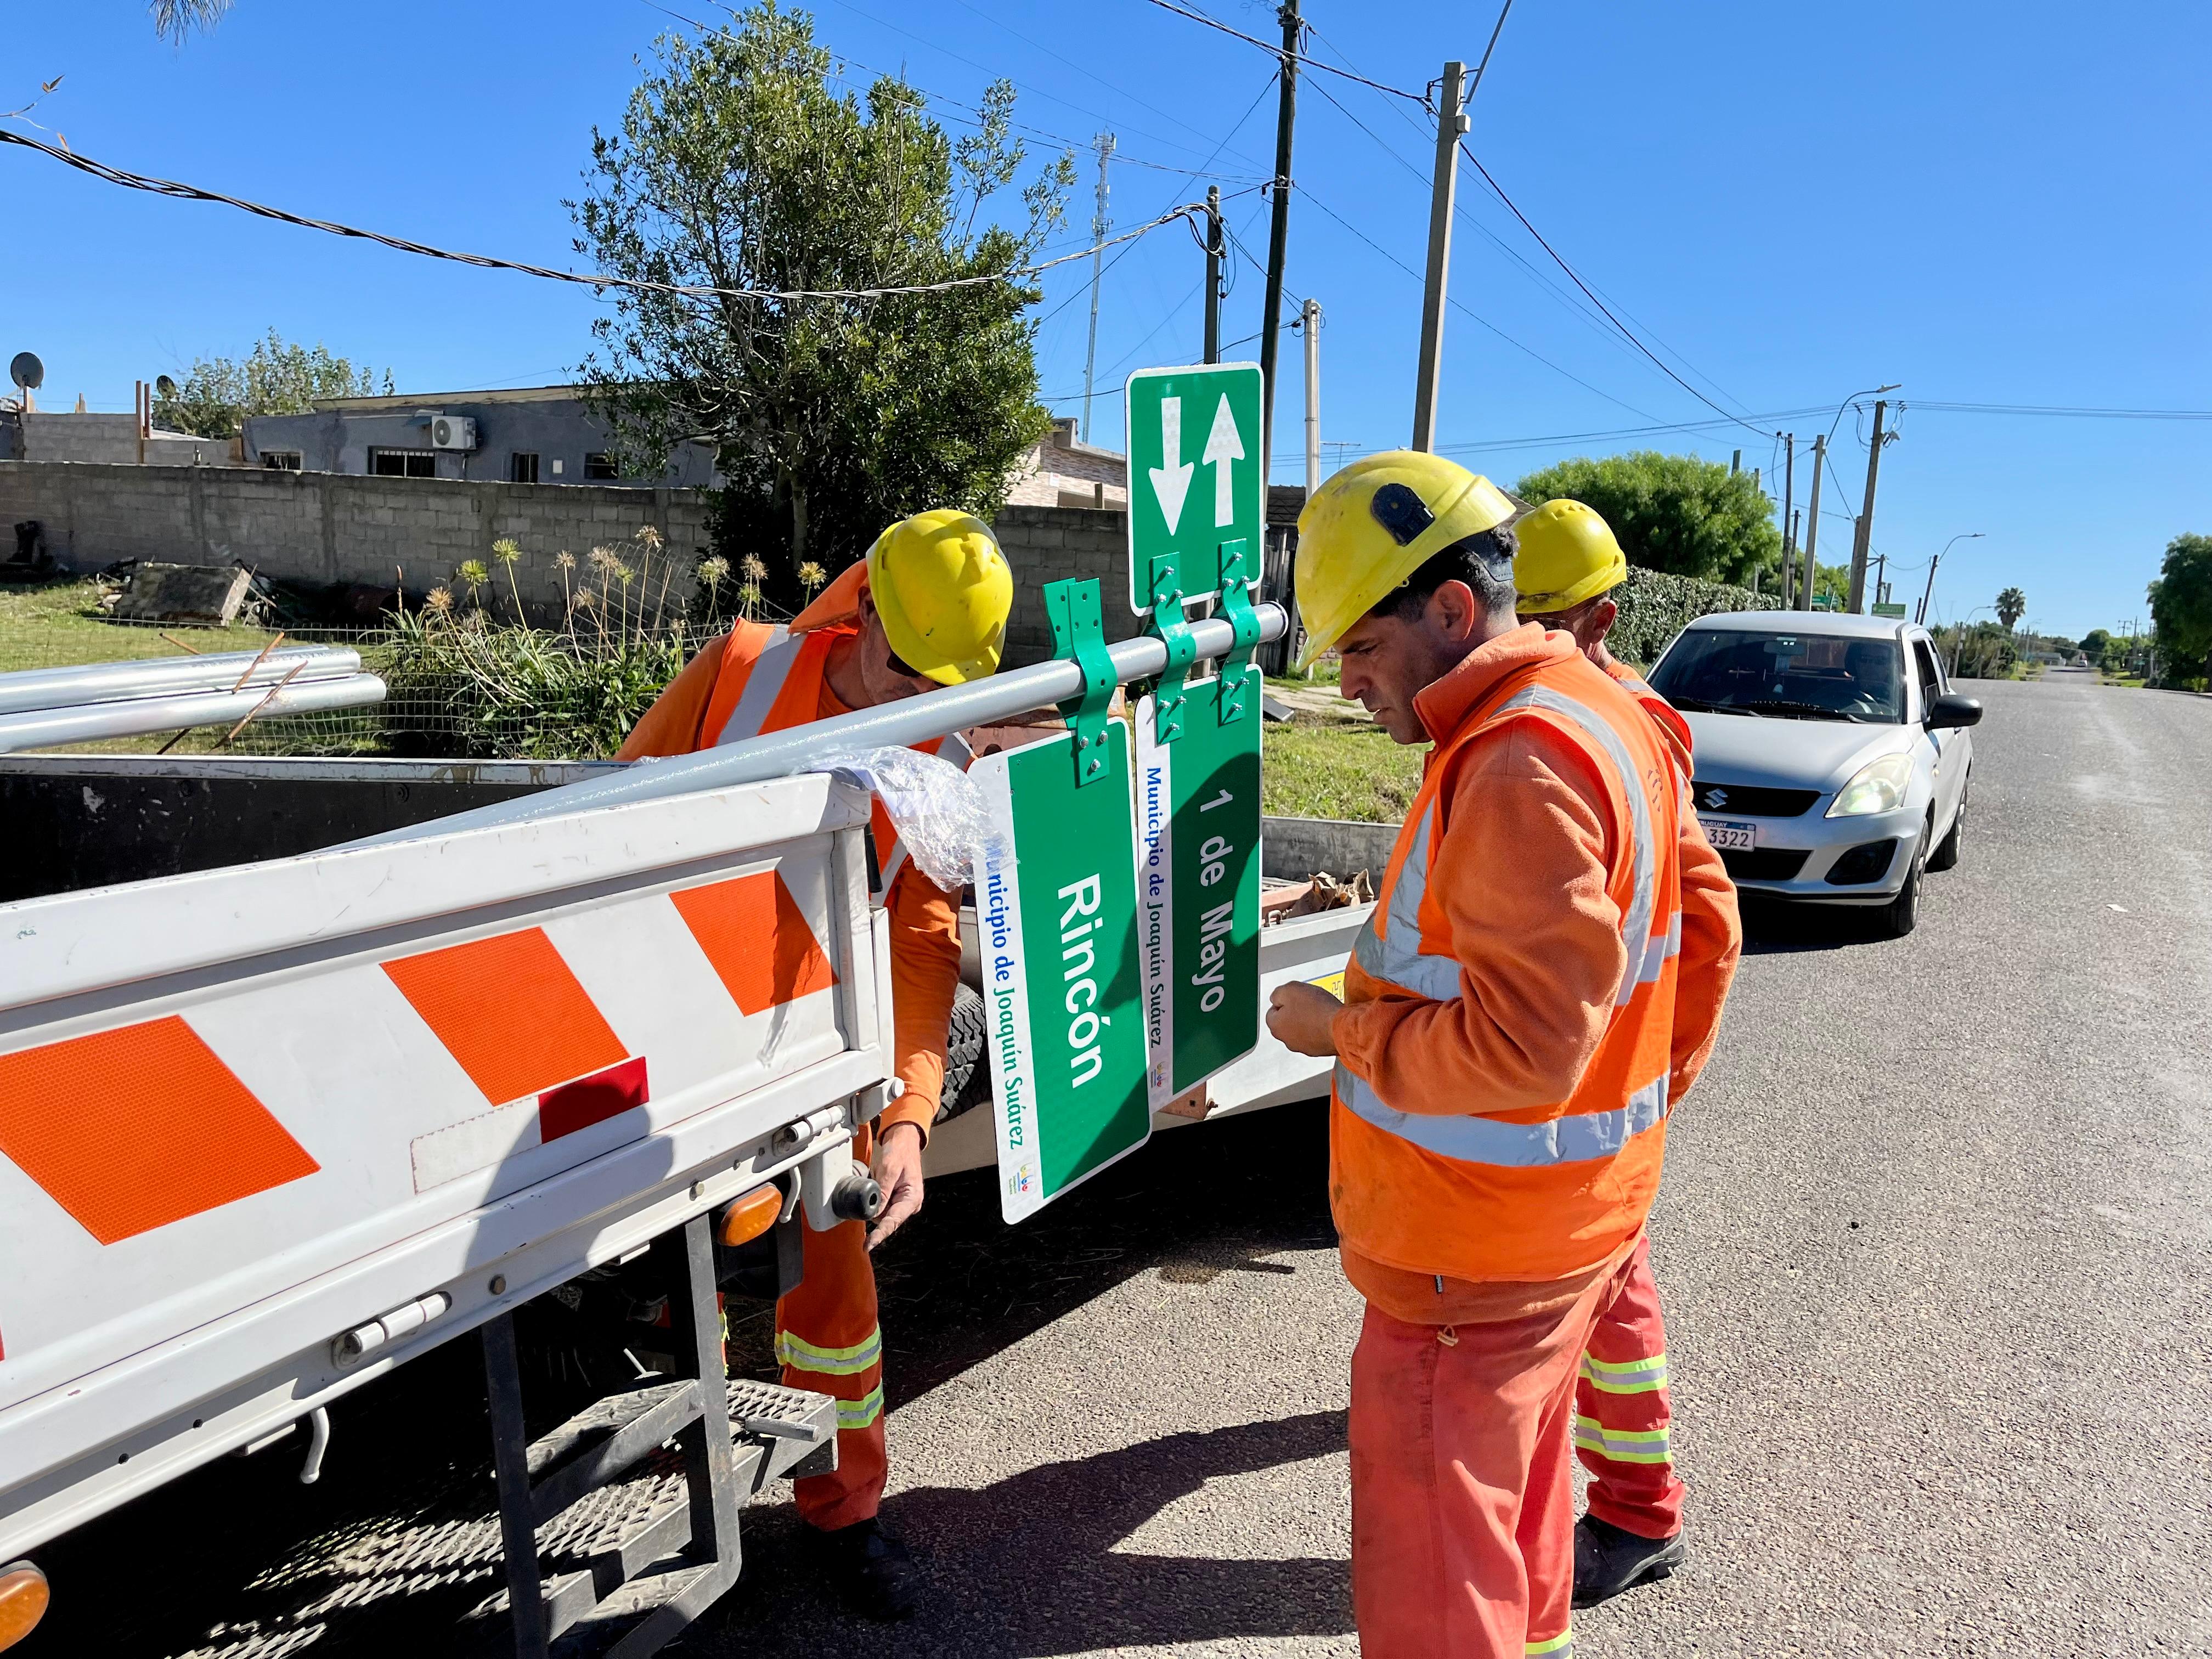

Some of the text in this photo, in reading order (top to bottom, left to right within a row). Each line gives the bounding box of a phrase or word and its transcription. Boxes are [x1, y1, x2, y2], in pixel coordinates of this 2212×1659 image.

[1708, 828, 1748, 847] 3322
[1144, 768, 1166, 1048] Municipio de Joaquín Suárez
[1192, 789, 1233, 1012] 1 de Mayo
[994, 956, 1015, 982] de
[1058, 873, 1111, 1088] Rincón
[993, 987, 1022, 1074] Joaquín
[1005, 1077, 1026, 1150] Suárez
